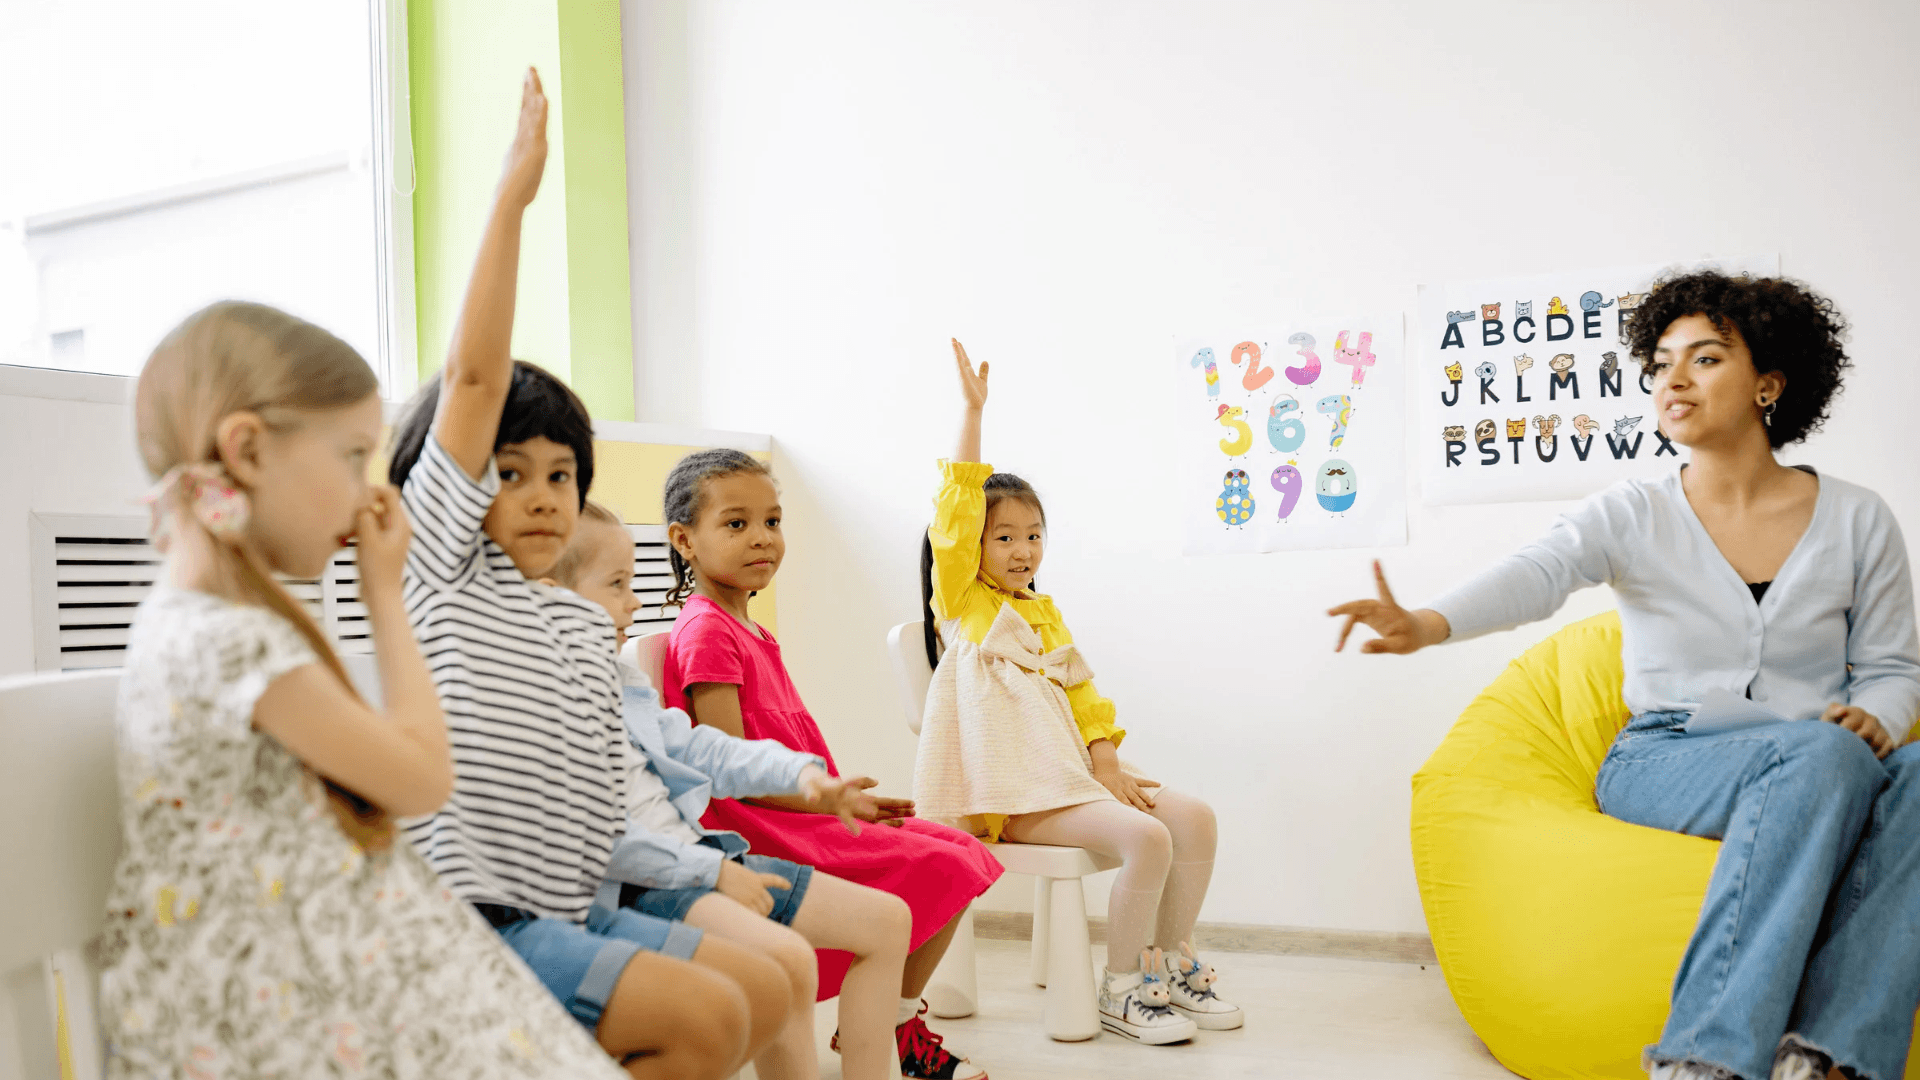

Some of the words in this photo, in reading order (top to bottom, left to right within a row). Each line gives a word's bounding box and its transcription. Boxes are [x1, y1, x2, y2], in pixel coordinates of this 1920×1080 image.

[1440, 322, 1465, 350] A
[1482, 318, 1505, 346] B
[1513, 316, 1536, 344] C
[1546, 314, 1574, 341] D
[1584, 310, 1602, 339] E
[1191, 347, 1220, 397] 1
[1231, 341, 1274, 391] 2
[1285, 332, 1322, 385] 3
[1334, 330, 1376, 384] 4
[1441, 380, 1463, 407] J
[1480, 378, 1500, 405] K
[1517, 375, 1531, 403] L
[1550, 372, 1580, 400] M
[1599, 368, 1622, 397] N
[1218, 406, 1253, 456] 5
[1267, 399, 1306, 453] 6
[1316, 395, 1351, 447] 7
[1446, 440, 1467, 467] R
[1480, 438, 1501, 465] S
[1507, 437, 1524, 464] T
[1536, 435, 1558, 463] U
[1570, 434, 1594, 462] V
[1605, 431, 1644, 460] W
[1654, 430, 1679, 457] X
[1216, 468, 1255, 525] 8
[1271, 465, 1302, 519] 9
[1316, 459, 1357, 512] 0
